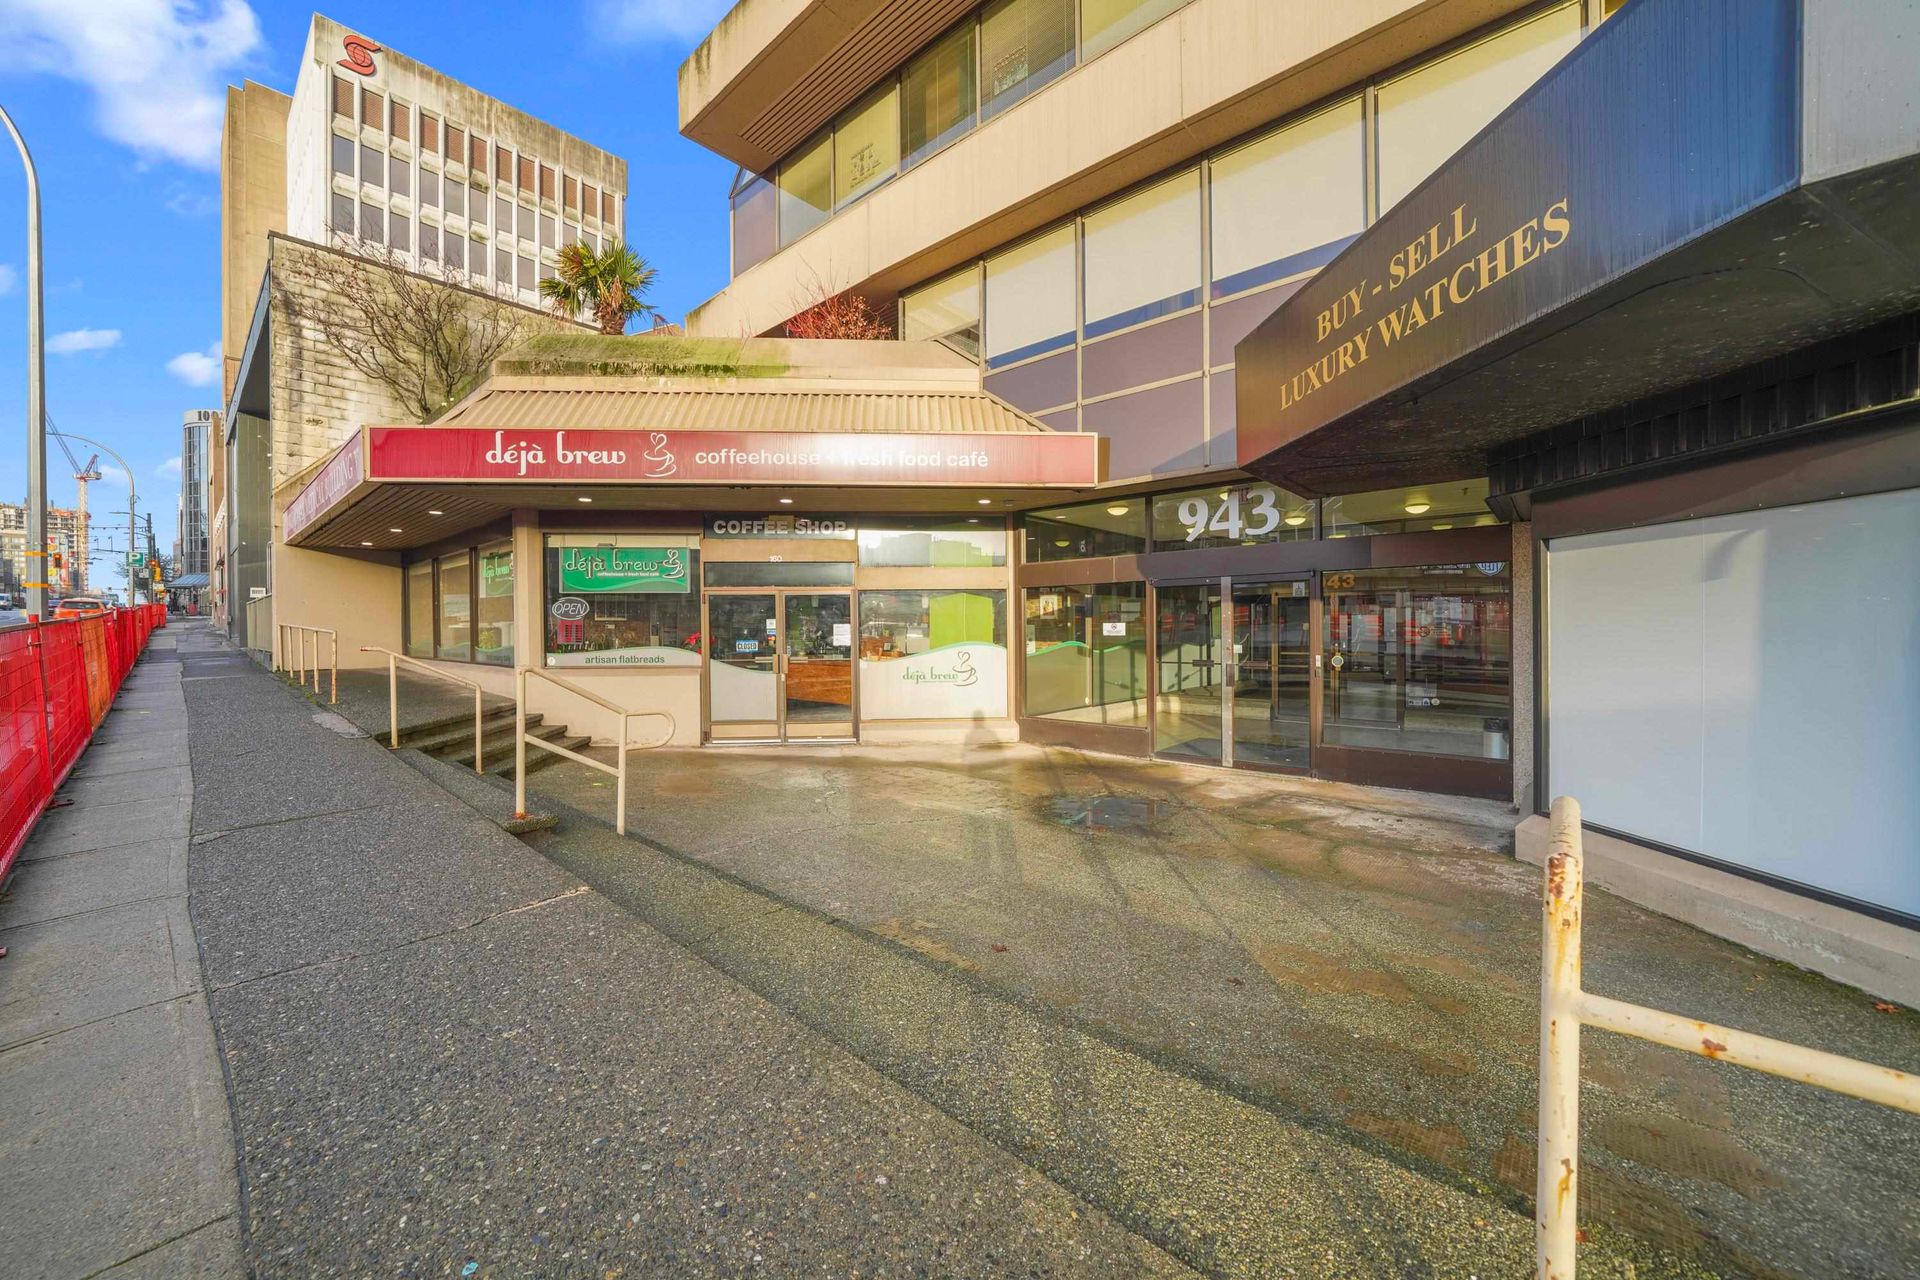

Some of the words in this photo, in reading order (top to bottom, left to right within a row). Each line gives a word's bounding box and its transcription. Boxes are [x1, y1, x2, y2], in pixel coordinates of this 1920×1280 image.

[1316, 279, 1367, 343] BUY
[1389, 203, 1478, 292] SELL
[1280, 326, 1374, 411] LUXURY
[1377, 198, 1571, 348] WATCHES
[485, 431, 546, 476] déjà
[556, 431, 626, 465] brew
[695, 448, 820, 466] coffeehouse
[898, 450, 941, 467] food
[947, 450, 989, 468] café
[1178, 487, 1280, 542] 943
[713, 520, 789, 535] COFFEE
[794, 520, 847, 535] SHOP
[612, 548, 659, 571] brew
[554, 602, 586, 615] OPEN
[585, 655, 617, 664] artisan
[619, 655, 665, 664] flatbreads
[930, 666, 958, 680] brew
